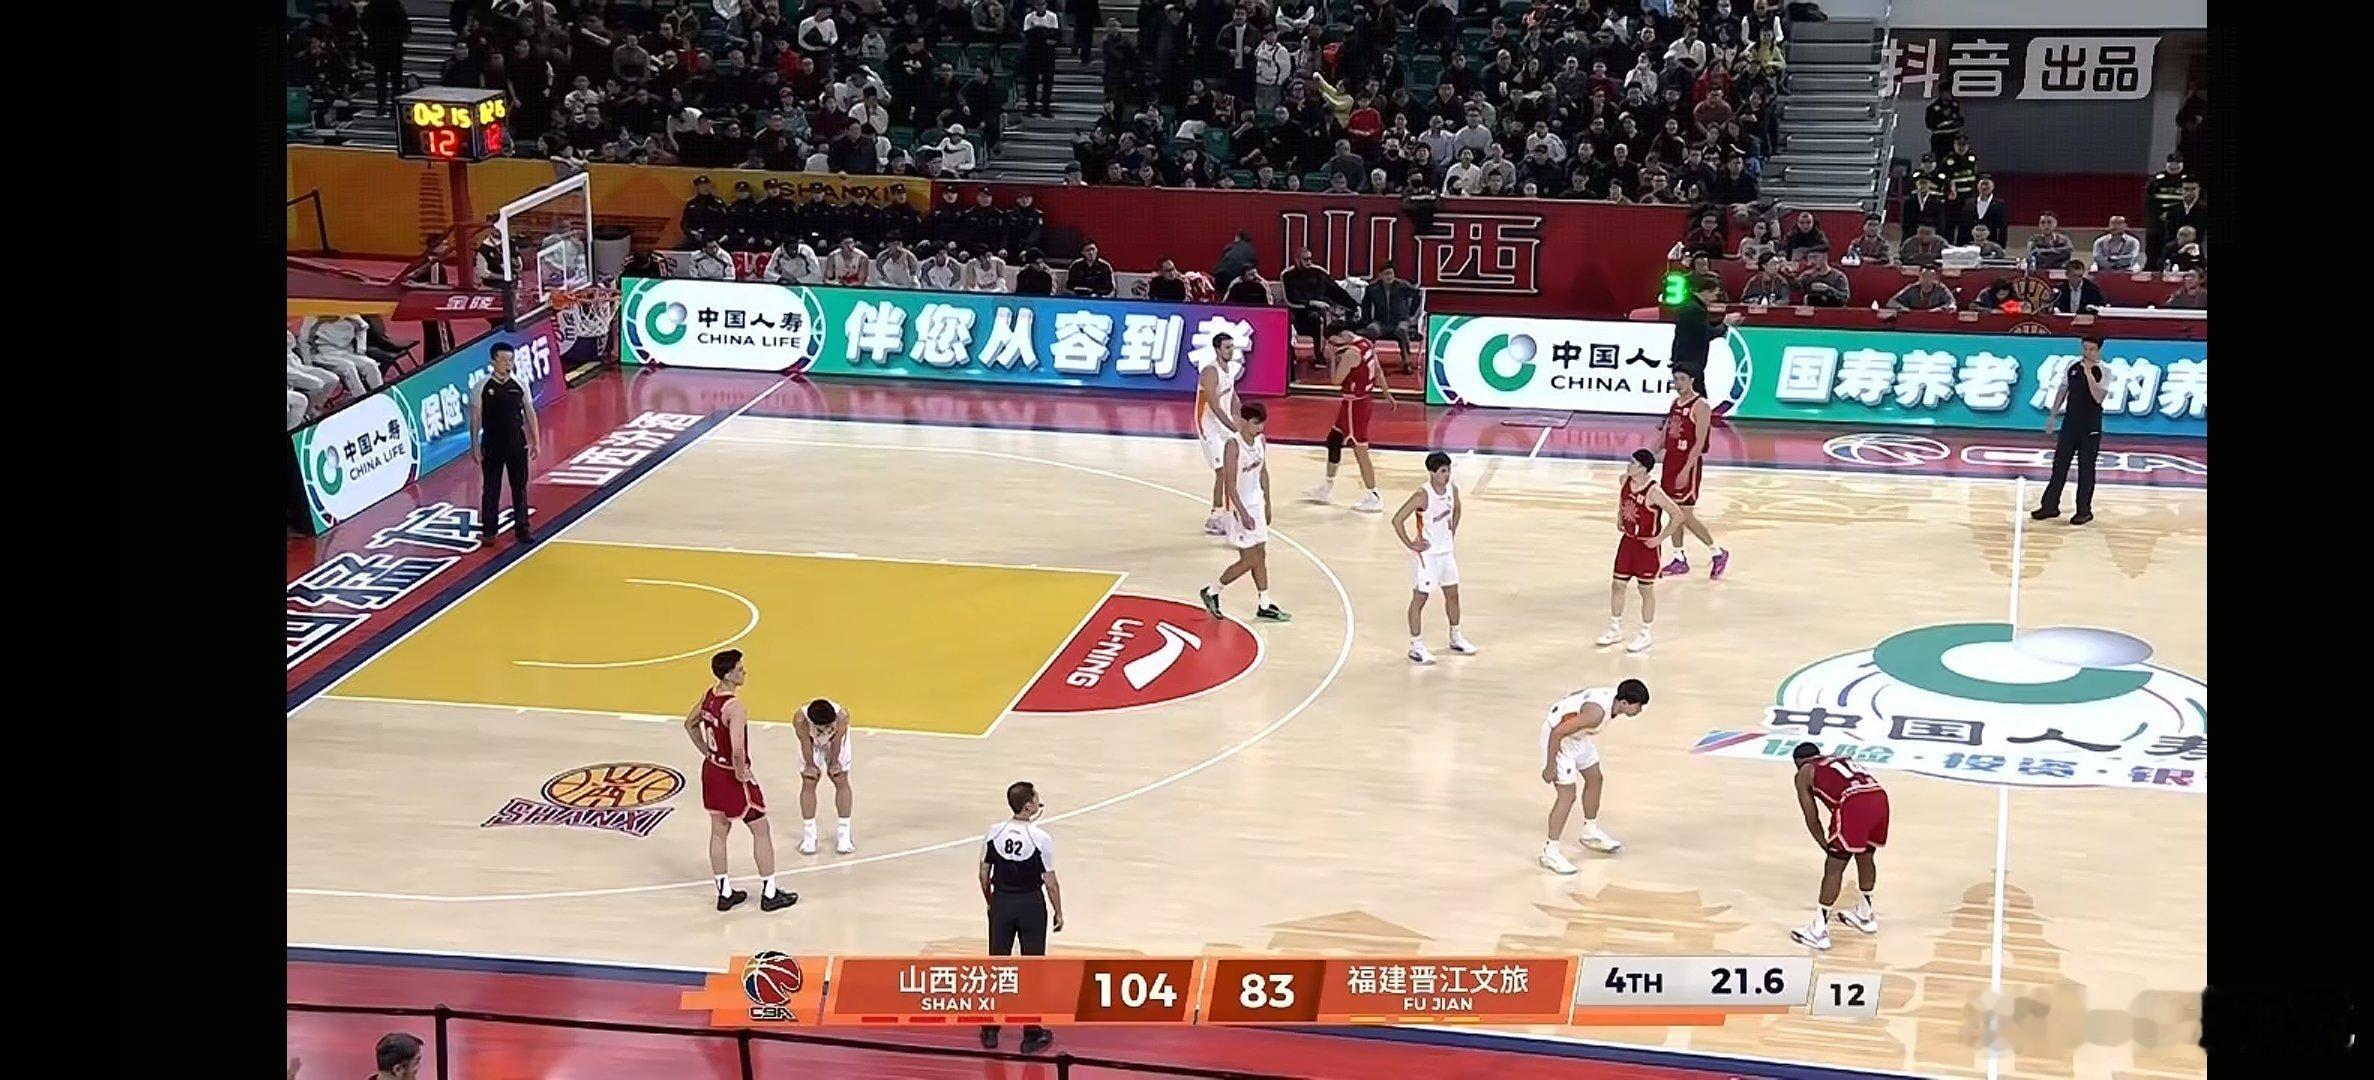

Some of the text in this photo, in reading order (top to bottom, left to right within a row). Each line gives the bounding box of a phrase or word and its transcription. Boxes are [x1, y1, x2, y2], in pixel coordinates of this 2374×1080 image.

[429, 130, 455, 156] 12
[1283, 210, 1542, 293] 山西
[697, 307, 803, 333] 中国人寿
[697, 333, 801, 349] CHINA LIFE
[844, 300, 1256, 380] 伴您从容到老
[1552, 340, 1675, 369] 中国人
[1550, 375, 1676, 394] CHINA LIF
[1776, 345, 2021, 411] 国寿养老
[344, 418, 401, 463] 中国人寿
[349, 443, 406, 481] CHINA LIFE
[1066, 618, 1144, 688] LI-NING
[481, 797, 674, 837] SHANXI
[1004, 838, 1023, 856] 82
